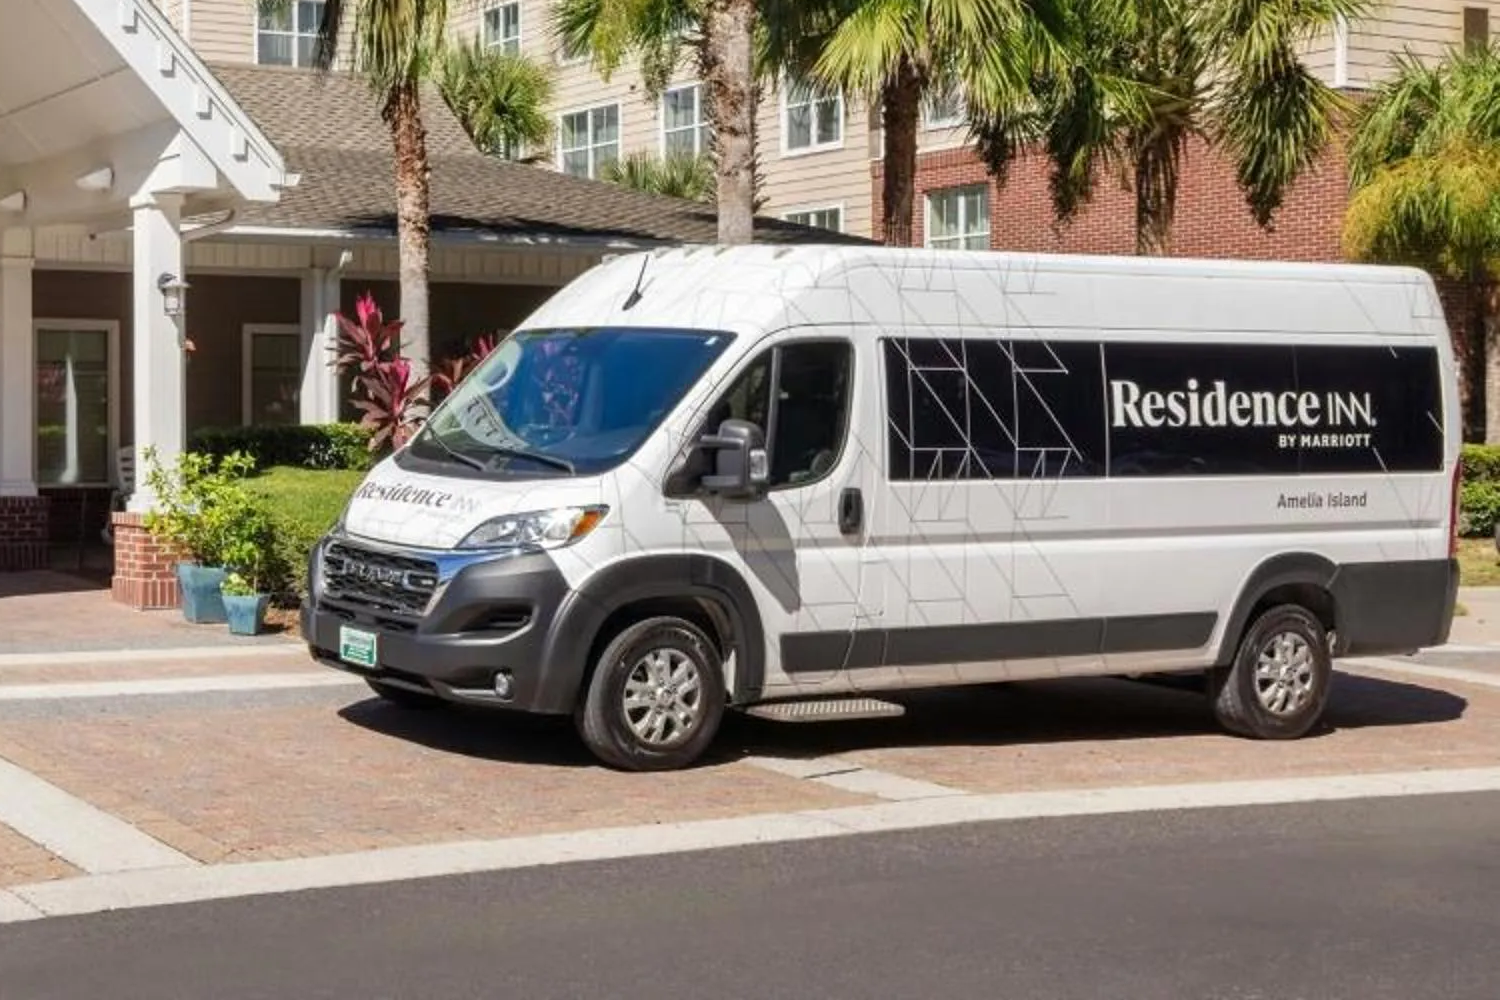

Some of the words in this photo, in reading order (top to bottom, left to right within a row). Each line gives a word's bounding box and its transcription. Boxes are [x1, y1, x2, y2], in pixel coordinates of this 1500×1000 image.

[1109, 378, 1321, 428] Residence
[1278, 433, 1297, 449] BY
[1300, 432, 1372, 448] MARRIOTT
[356, 480, 453, 507] Residence
[1277, 491, 1323, 509] Amelia
[1327, 490, 1368, 508] Island
